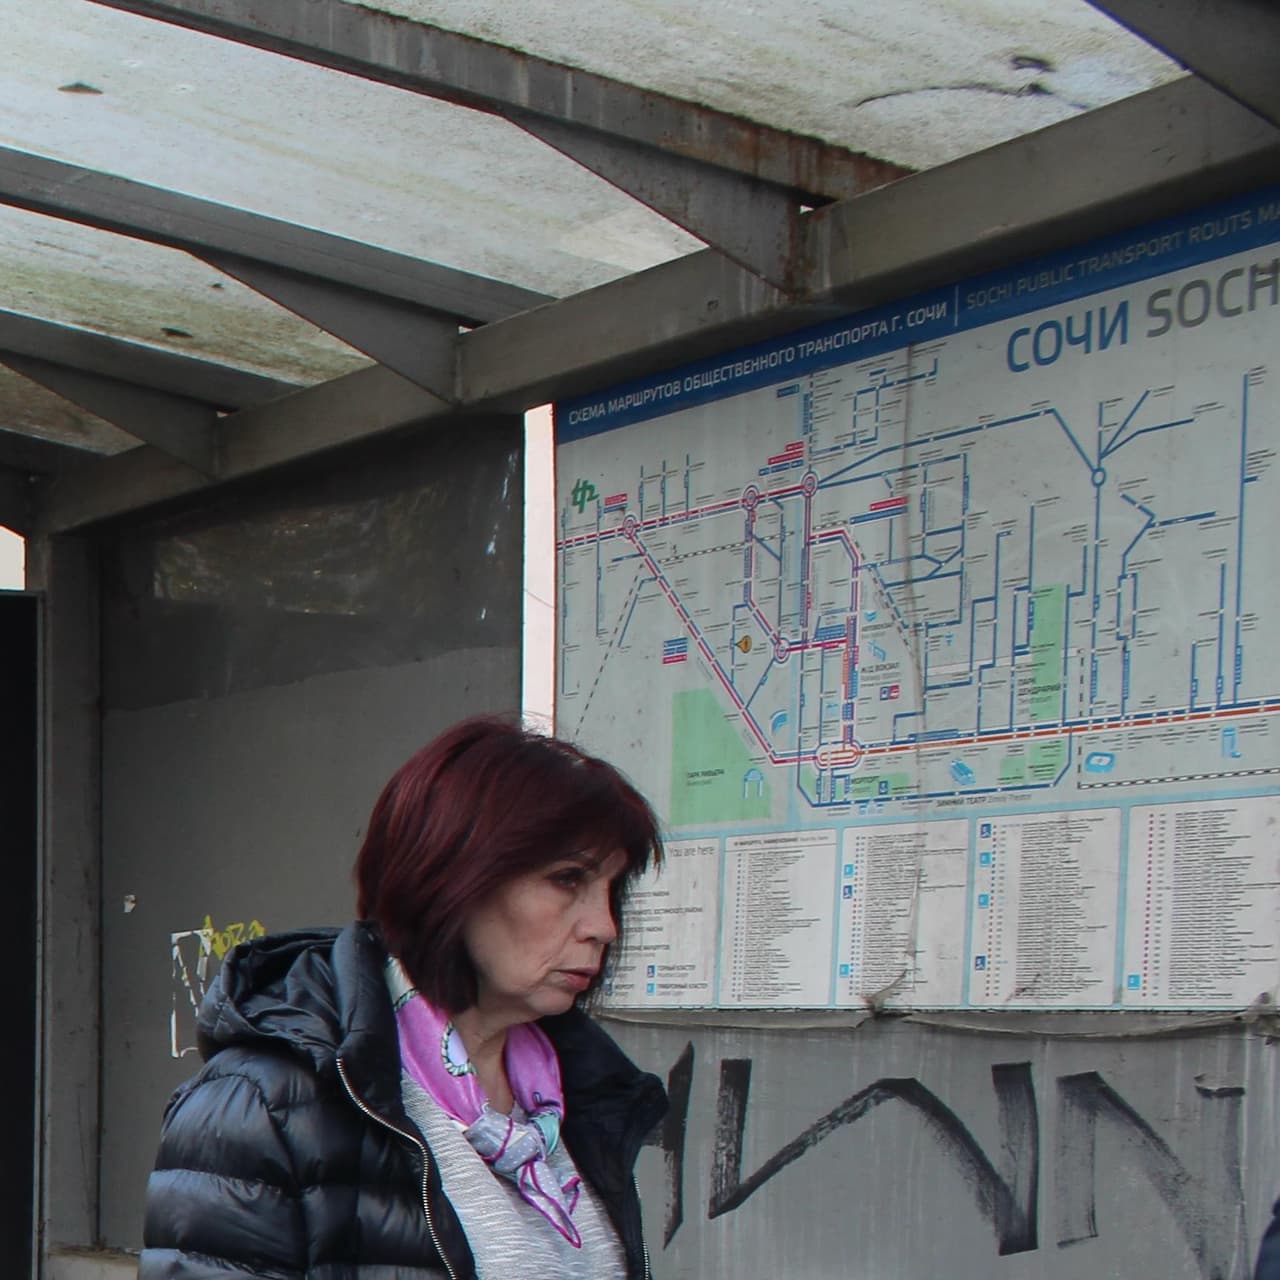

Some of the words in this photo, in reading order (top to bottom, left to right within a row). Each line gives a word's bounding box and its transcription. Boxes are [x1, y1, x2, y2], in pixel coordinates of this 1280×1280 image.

[967, 283, 1013, 311] SOCHI
[1016, 263, 1074, 296] PUBLIC
[1078, 230, 1185, 277] TRANSPORT
[1187, 210, 1253, 243] ROUTS
[568, 403, 606, 426] СХЕМА
[607, 380, 682, 417] МАРШРУТОВ
[684, 346, 796, 393] ОБЩЕСТВЕННОГО
[797, 320, 890, 359] ТРАНСПОРТА
[891, 316, 904, 335] Г.
[907, 302, 948, 328] СОЧИ
[1007, 300, 1129, 374] СОЧИ
